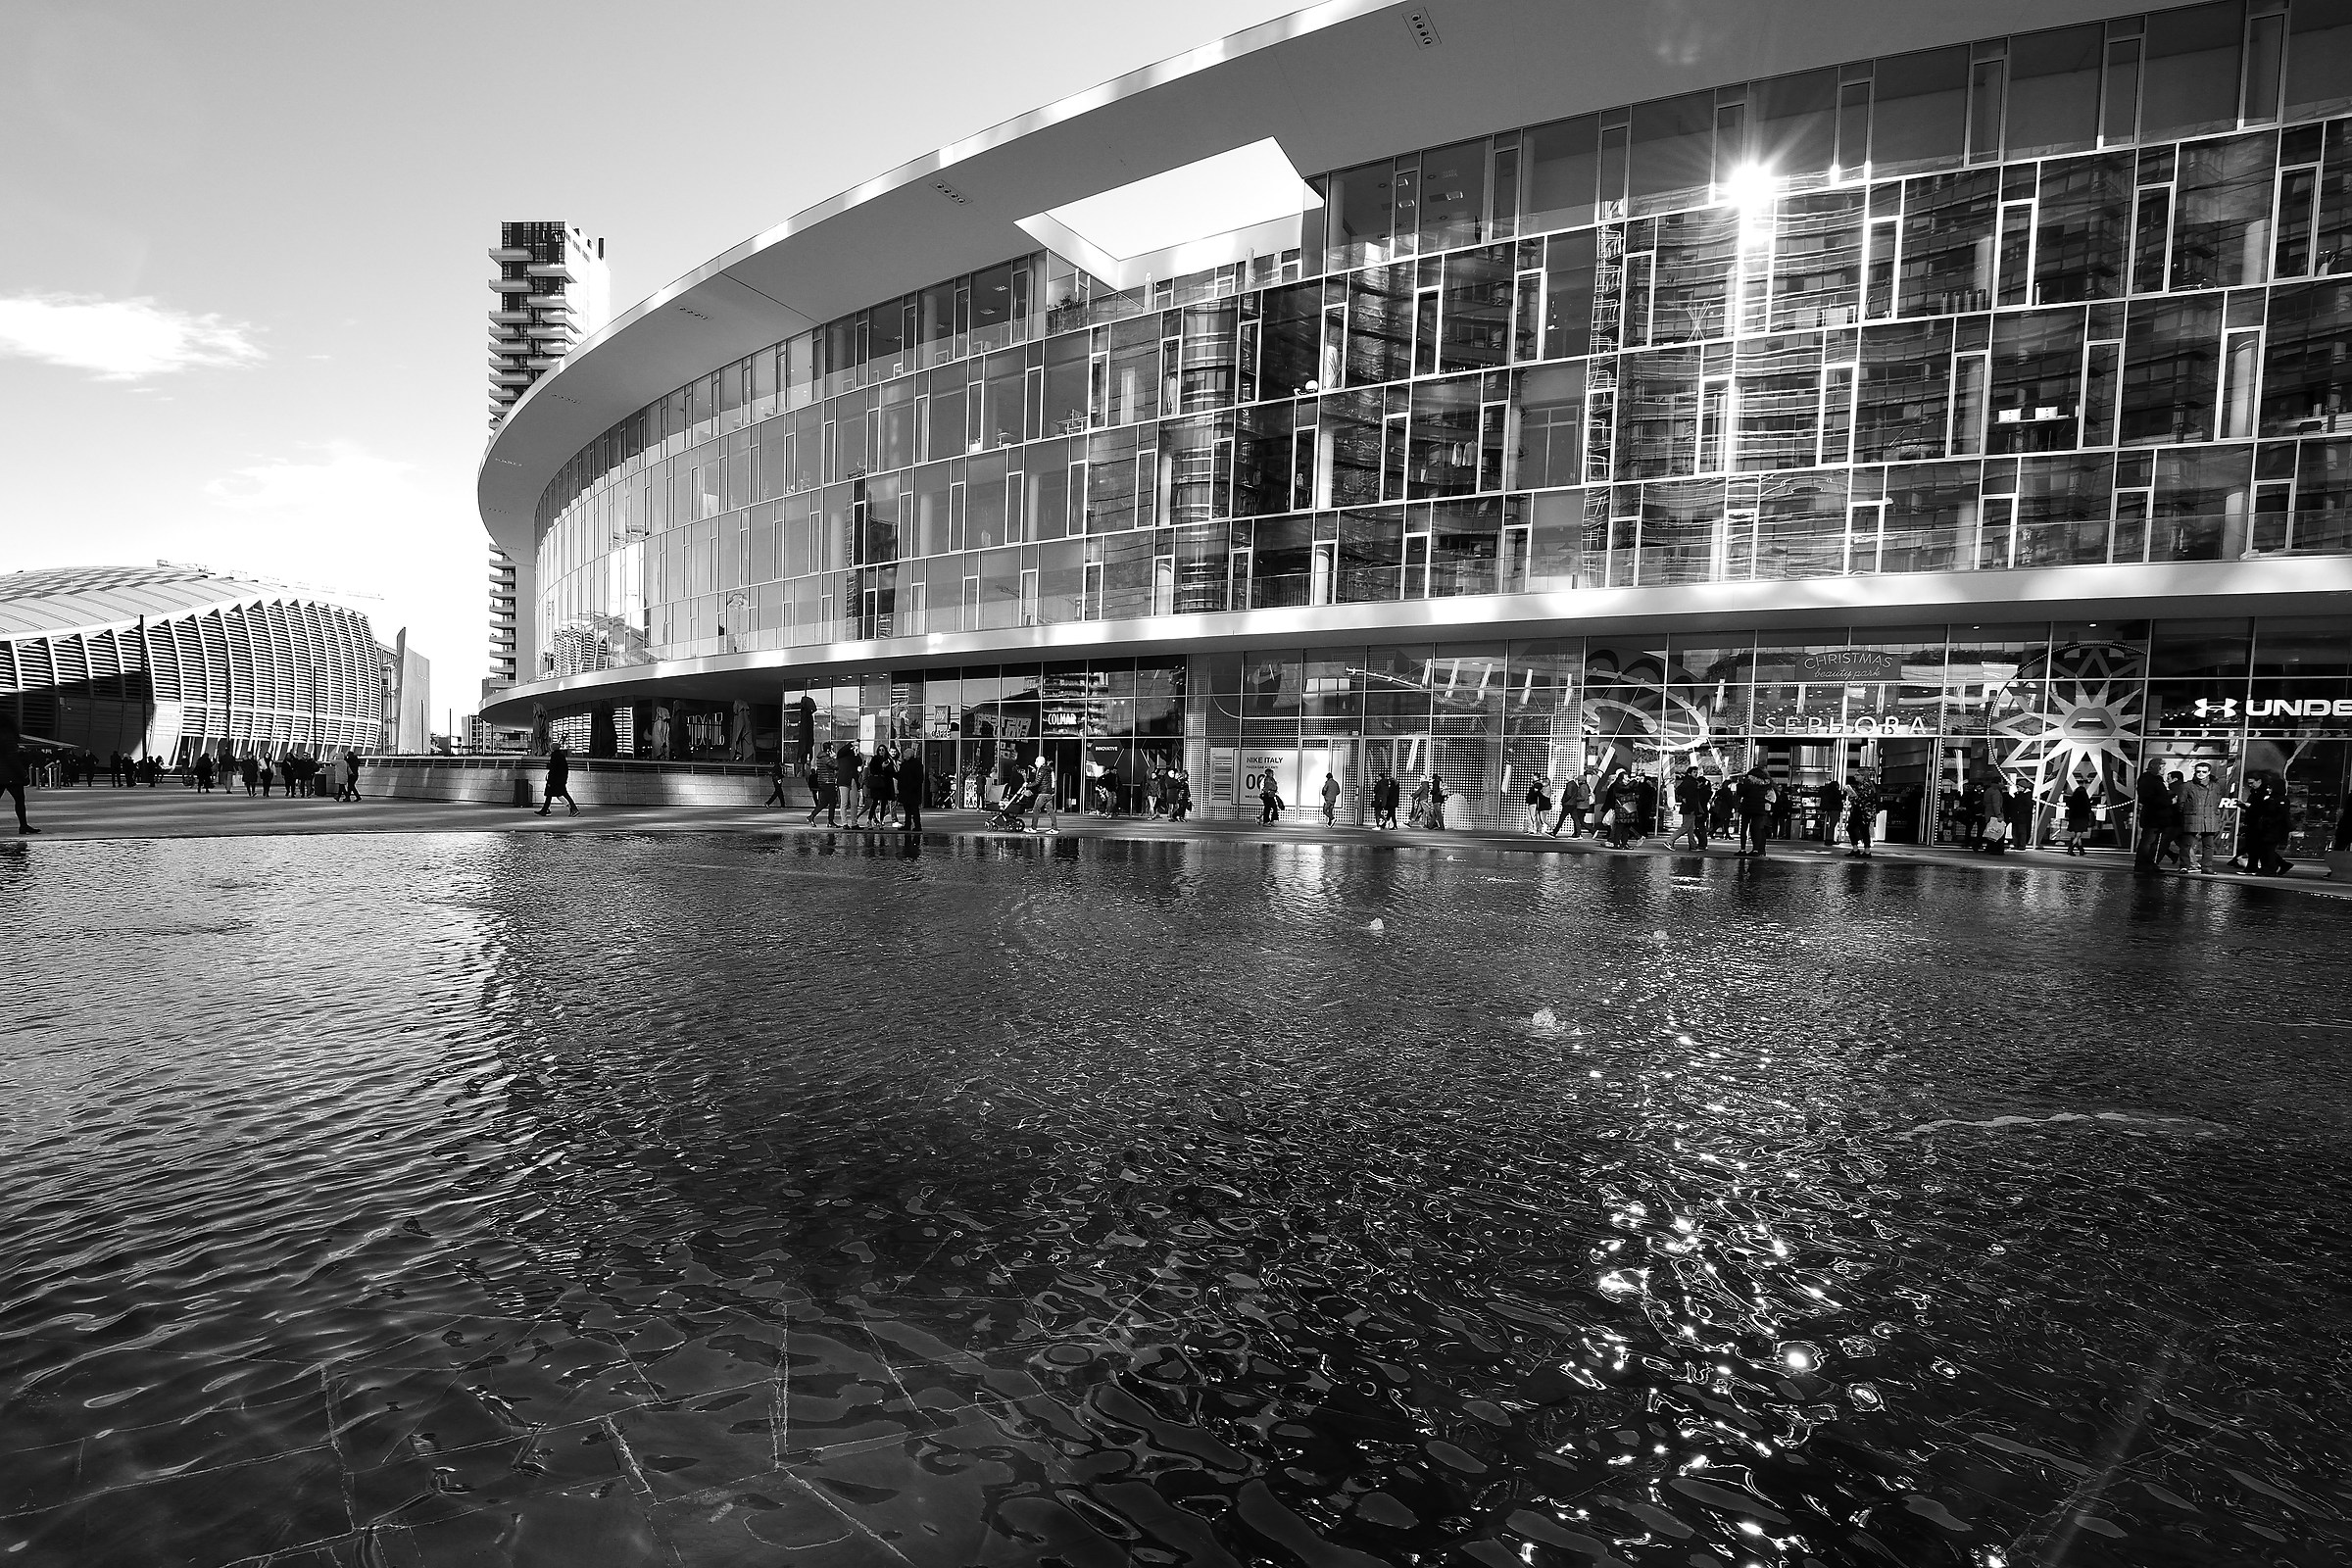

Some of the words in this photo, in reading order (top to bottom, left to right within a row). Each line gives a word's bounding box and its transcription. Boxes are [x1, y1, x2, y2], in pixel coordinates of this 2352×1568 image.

[1804, 653, 1892, 669] CHRISTMAS
[1814, 667, 1851, 680] beauty
[1852, 666, 1881, 680] park
[2245, 699, 2352, 716] UNDE
[1048, 712, 1078, 725] COLMAR
[1764, 716, 1928, 735] SEPHORA
